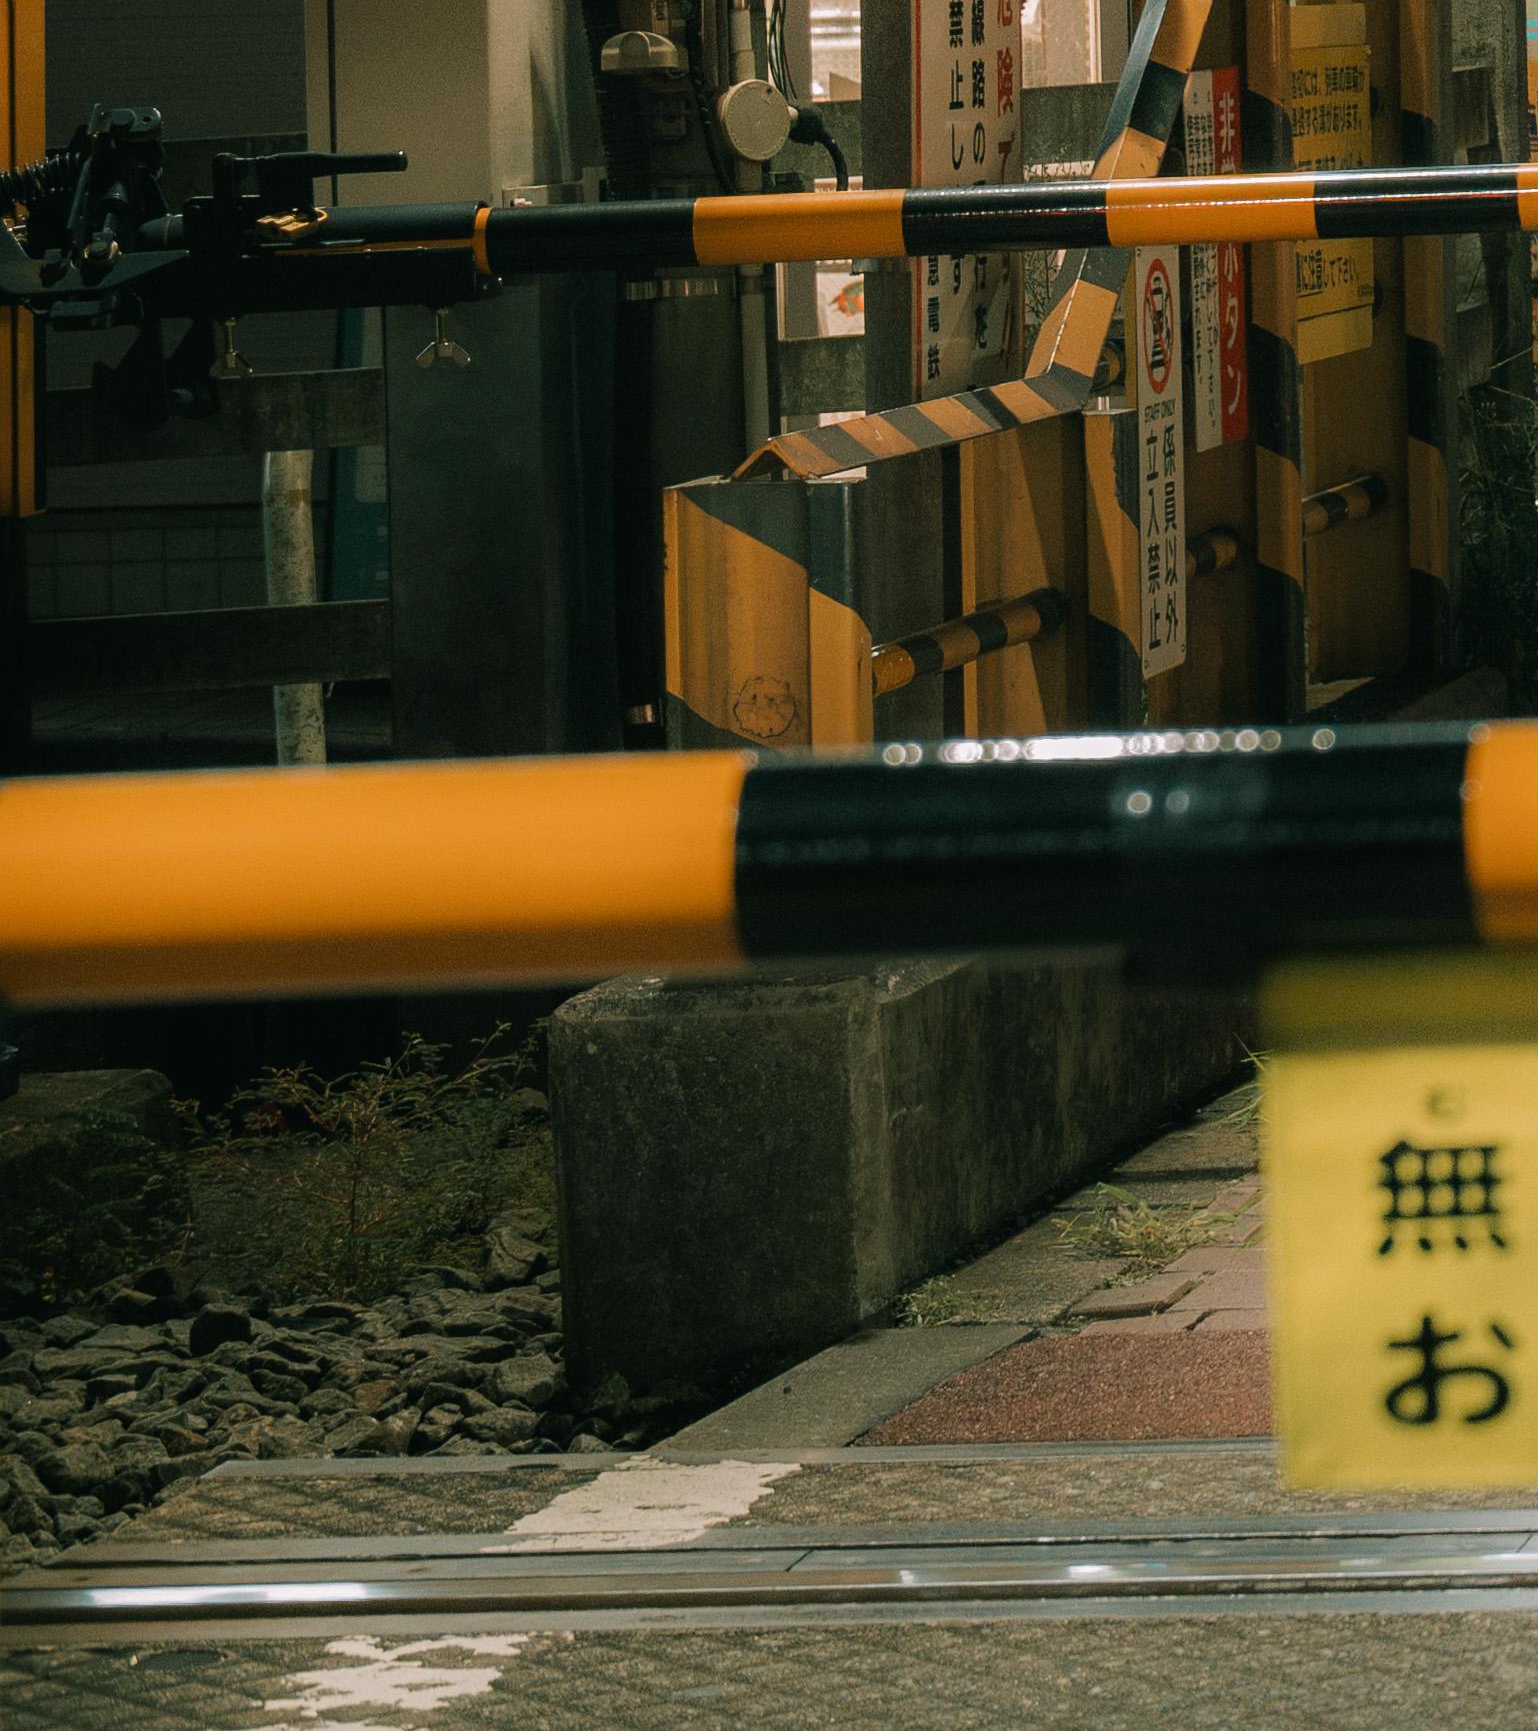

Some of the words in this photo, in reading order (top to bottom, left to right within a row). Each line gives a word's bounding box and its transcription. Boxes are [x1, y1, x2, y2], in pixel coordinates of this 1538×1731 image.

[1145, 428, 1161, 651] 立入禁止
[1163, 423, 1178, 644] 係員以外
